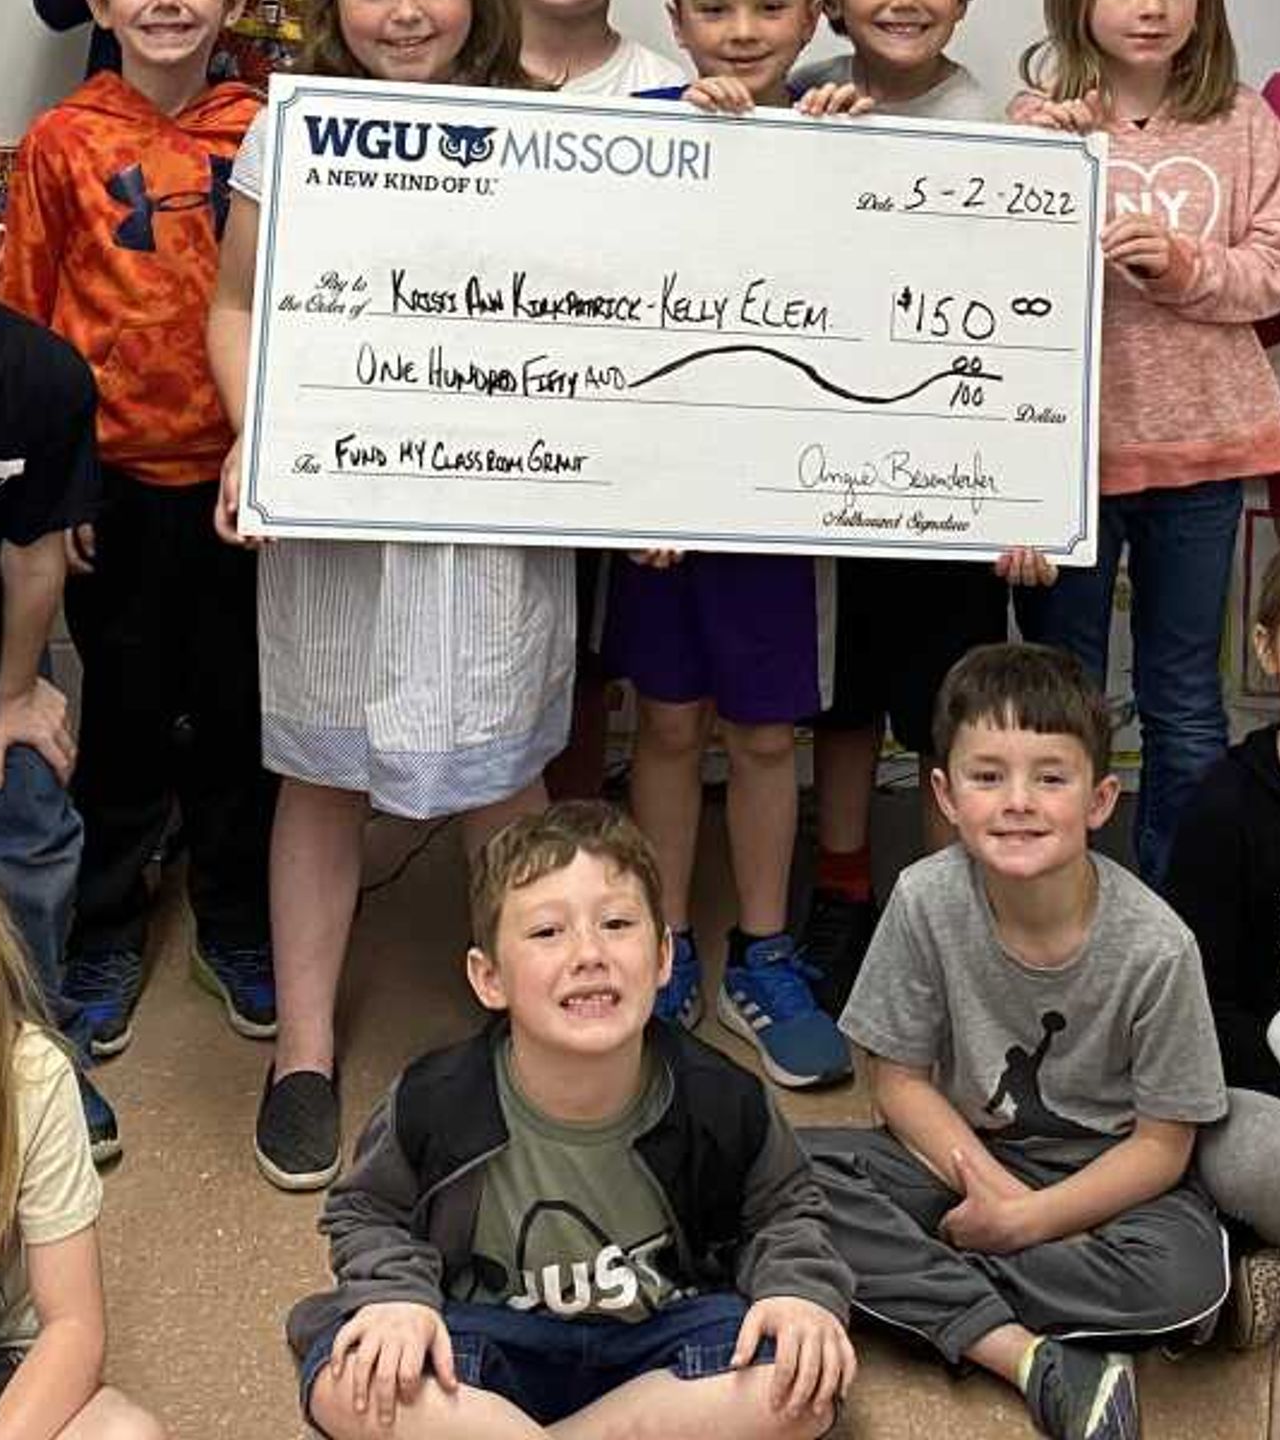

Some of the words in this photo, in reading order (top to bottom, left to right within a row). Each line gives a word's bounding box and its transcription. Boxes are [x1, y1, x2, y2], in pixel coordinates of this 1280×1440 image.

[303, 114, 429, 162] WGU
[499, 129, 713, 181] MISSOURI
[327, 169, 379, 189] NEW
[383, 172, 440, 192] KIND
[440, 177, 472, 193] OF
[857, 190, 895, 211] Date
[315, 271, 348, 294] Pay
[278, 294, 302, 311] the
[303, 293, 345, 313] Order
[896, 284, 996, 340] $150
[356, 342, 418, 385] ONE
[522, 355, 580, 398] FIFTY
[1014, 403, 1067, 424] Dollars
[292, 453, 322, 474] For
[334, 433, 387, 469] FUND
[399, 440, 426, 469] MY
[527, 439, 589, 474] GRANT
[822, 509, 900, 529] Authorized
[906, 511, 970, 535] Signature
